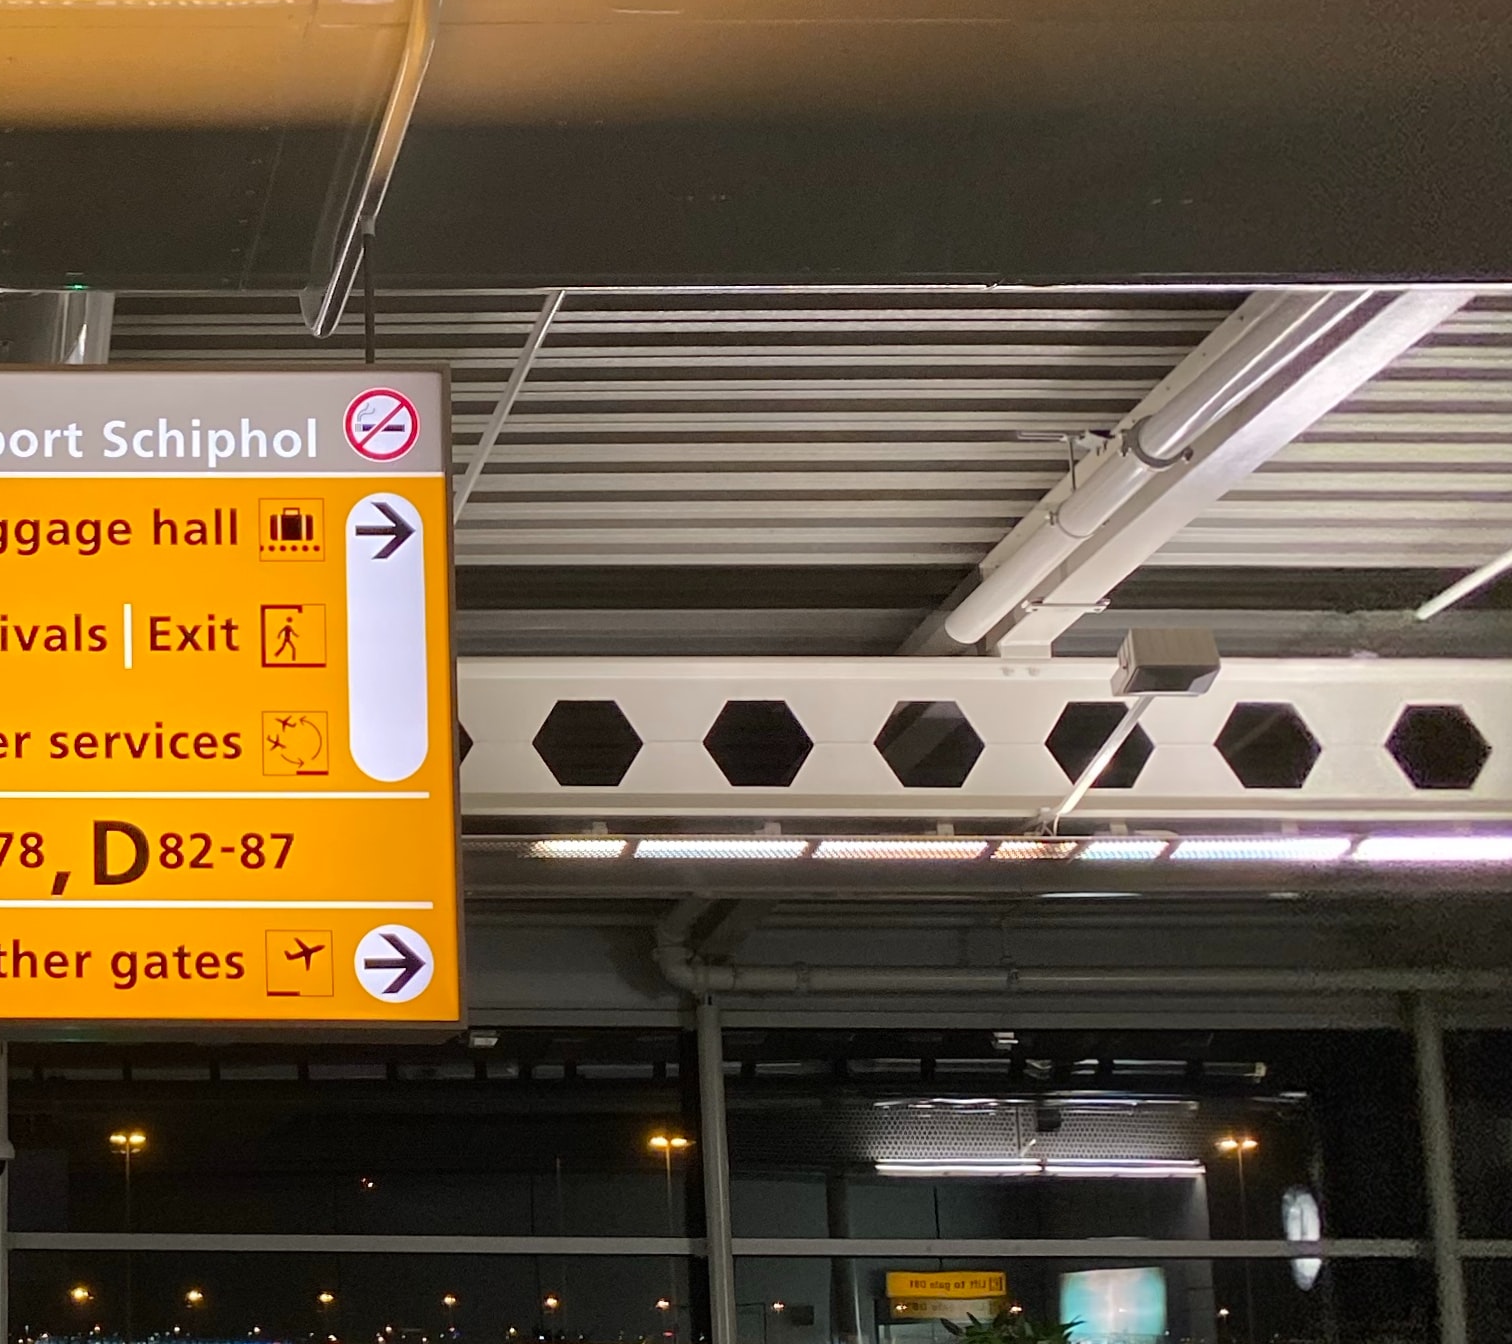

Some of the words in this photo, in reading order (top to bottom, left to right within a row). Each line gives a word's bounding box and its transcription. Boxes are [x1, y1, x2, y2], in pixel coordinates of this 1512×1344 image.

[103, 417, 317, 468] Schiphol
[153, 508, 238, 546] hall
[149, 614, 239, 652] Exit
[50, 721, 242, 760] services
[110, 944, 245, 990] gates
